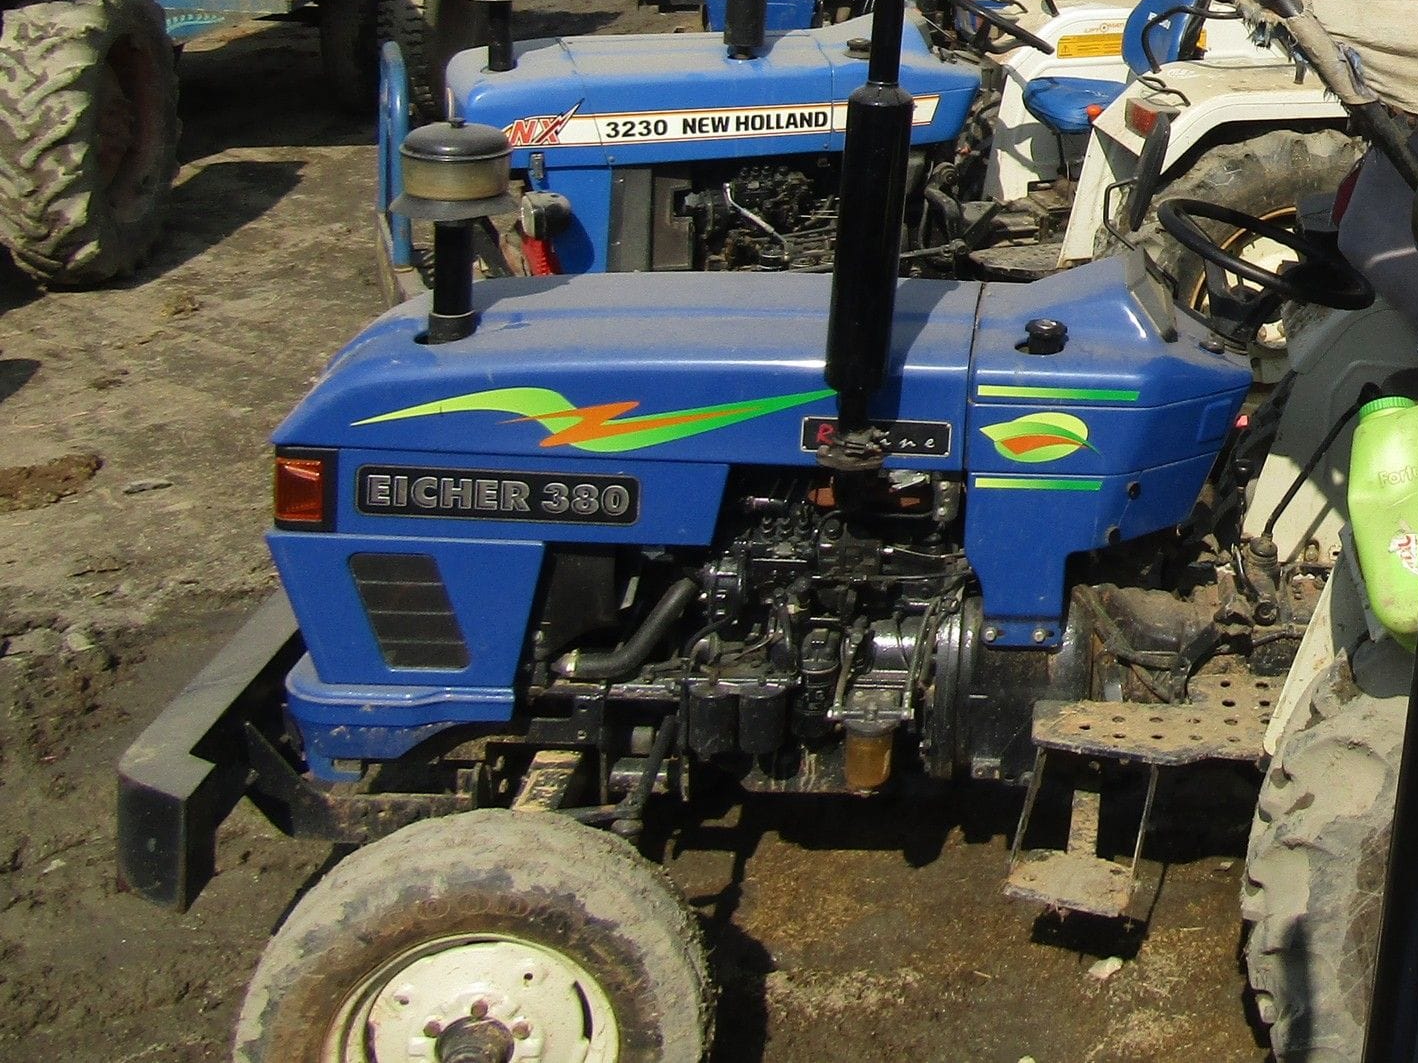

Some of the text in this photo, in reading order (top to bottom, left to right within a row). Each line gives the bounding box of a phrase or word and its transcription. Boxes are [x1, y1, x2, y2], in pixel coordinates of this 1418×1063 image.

[511, 110, 829, 146] NX 3230 NEW HOLLAND
[365, 473, 630, 517] EICHER 380
